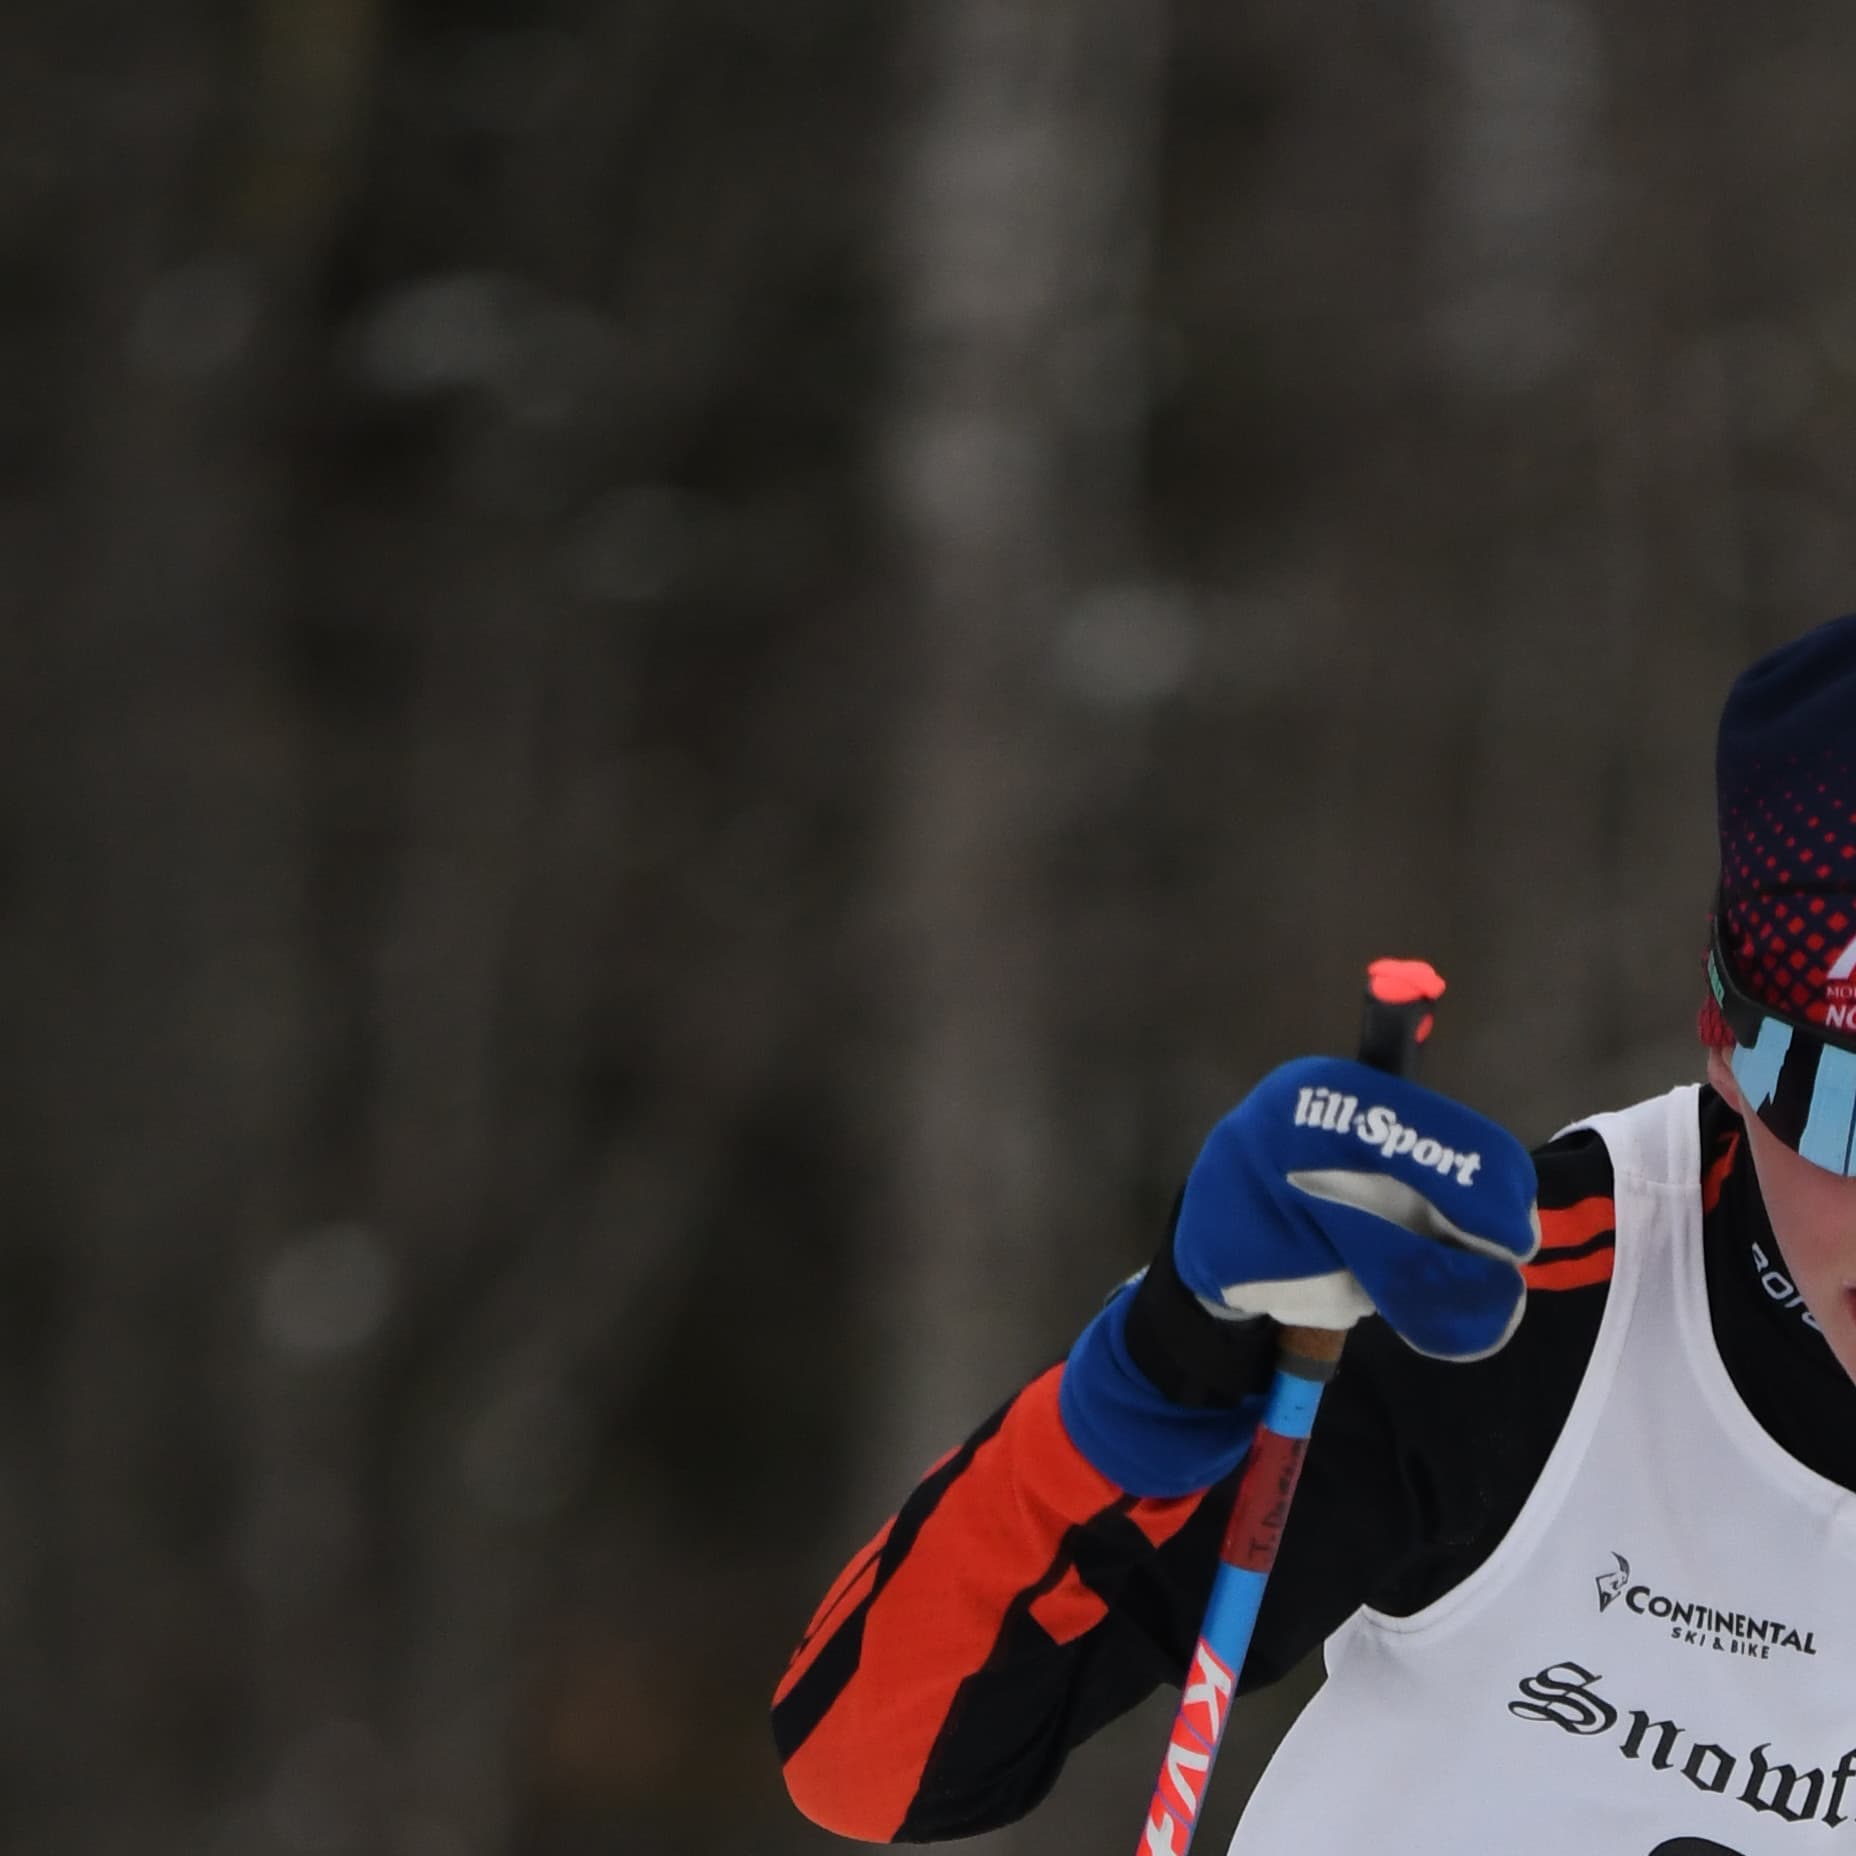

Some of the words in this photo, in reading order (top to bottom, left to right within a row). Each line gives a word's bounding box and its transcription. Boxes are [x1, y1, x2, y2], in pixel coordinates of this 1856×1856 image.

[1625, 1585, 1817, 1655] CONTINENTAL
[1670, 1626, 1706, 1647] SKI
[1712, 1637, 1727, 1651] &
[1730, 1639, 1770, 1660] BIKE
